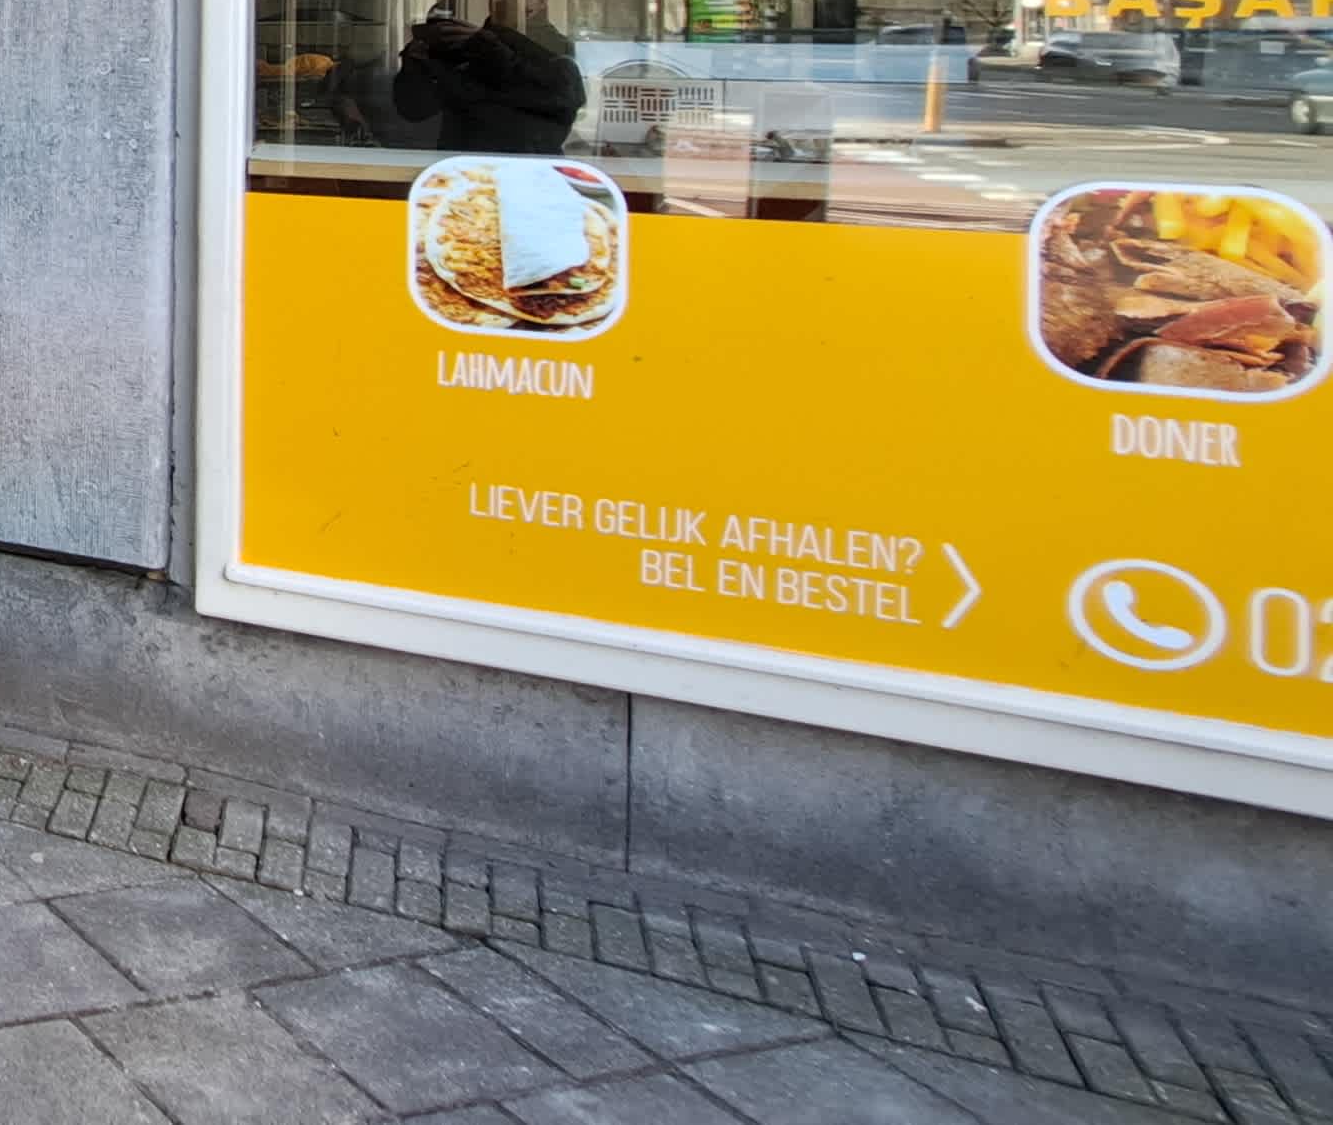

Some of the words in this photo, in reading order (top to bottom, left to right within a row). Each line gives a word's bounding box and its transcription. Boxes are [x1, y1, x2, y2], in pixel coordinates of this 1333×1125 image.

[437, 350, 595, 400] LAHMACUN
[1111, 412, 1242, 467] DONER
[469, 482, 583, 530] LIEVER
[594, 499, 707, 546] GELIJK
[720, 514, 923, 574] AFHALEN?
[640, 549, 706, 593] BEL
[717, 560, 765, 601] EN
[776, 568, 923, 625] BESTEL
[1249, 587, 1333, 683] 0
